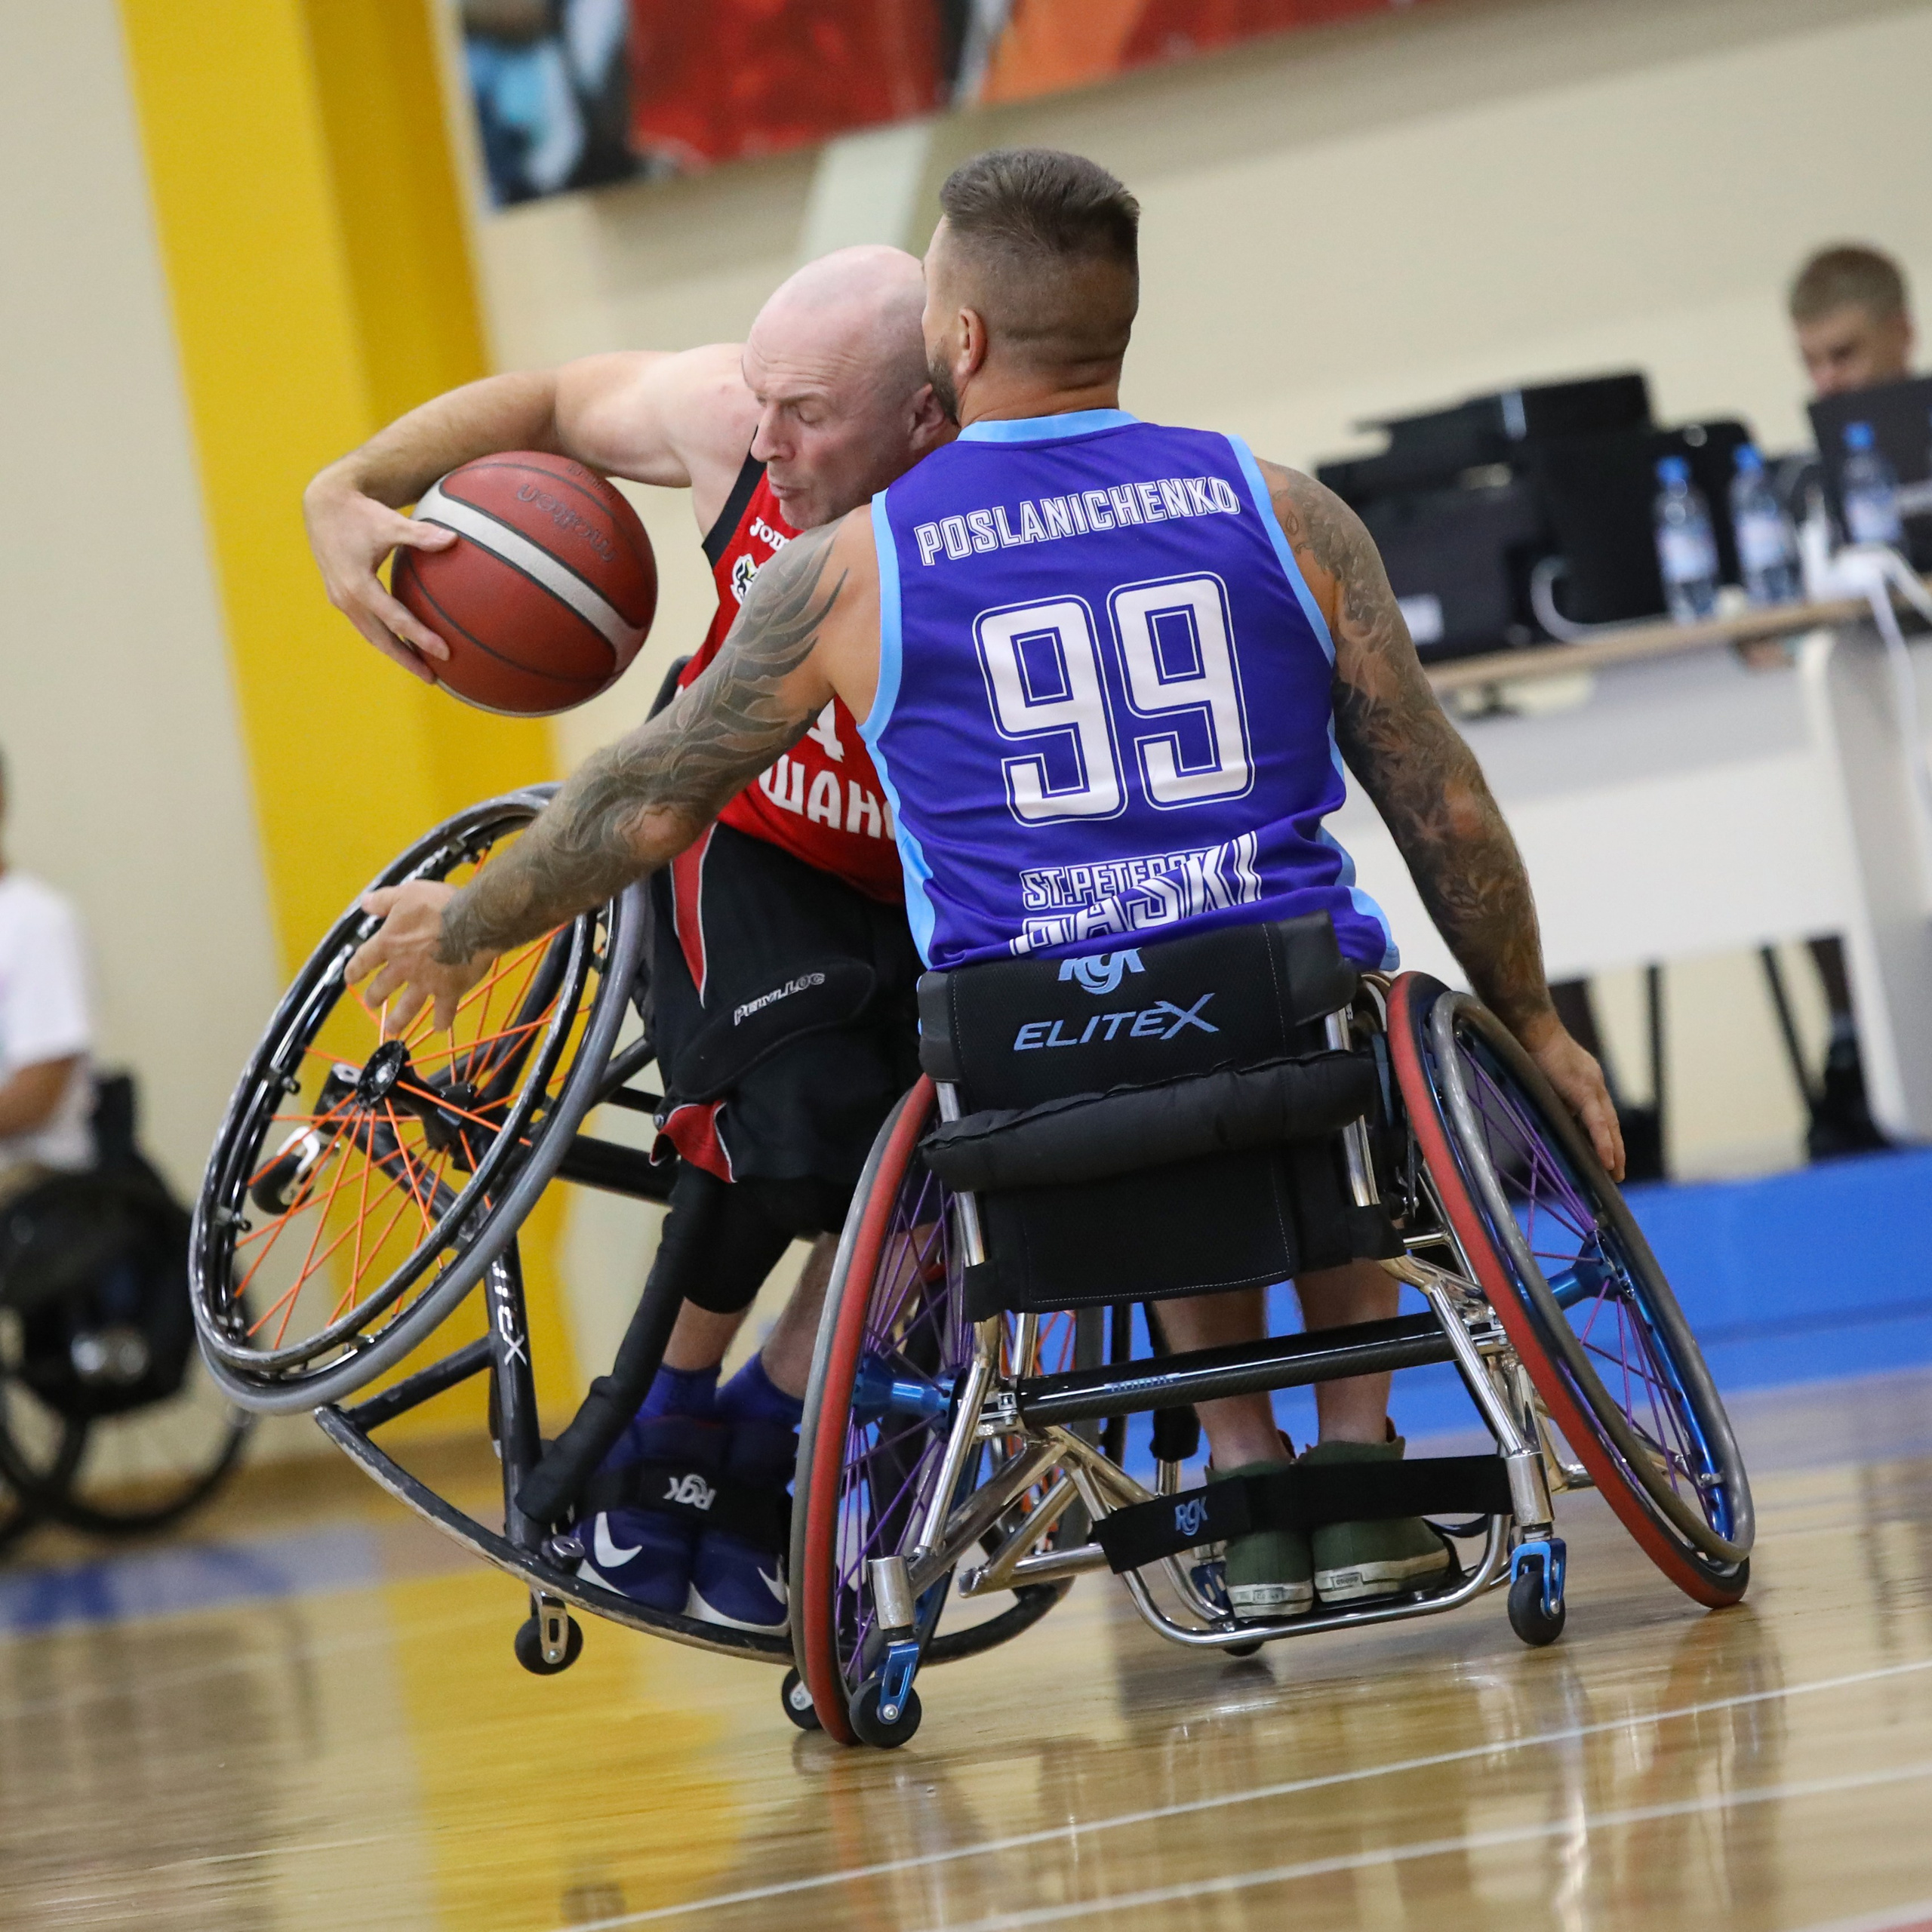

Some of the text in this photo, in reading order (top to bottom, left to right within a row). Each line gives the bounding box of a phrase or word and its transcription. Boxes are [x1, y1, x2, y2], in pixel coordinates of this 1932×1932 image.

[913, 476, 1242, 567] POSLANICHENKO
[971, 570, 1256, 828] 99
[1013, 992, 1220, 1051] ELITEX
